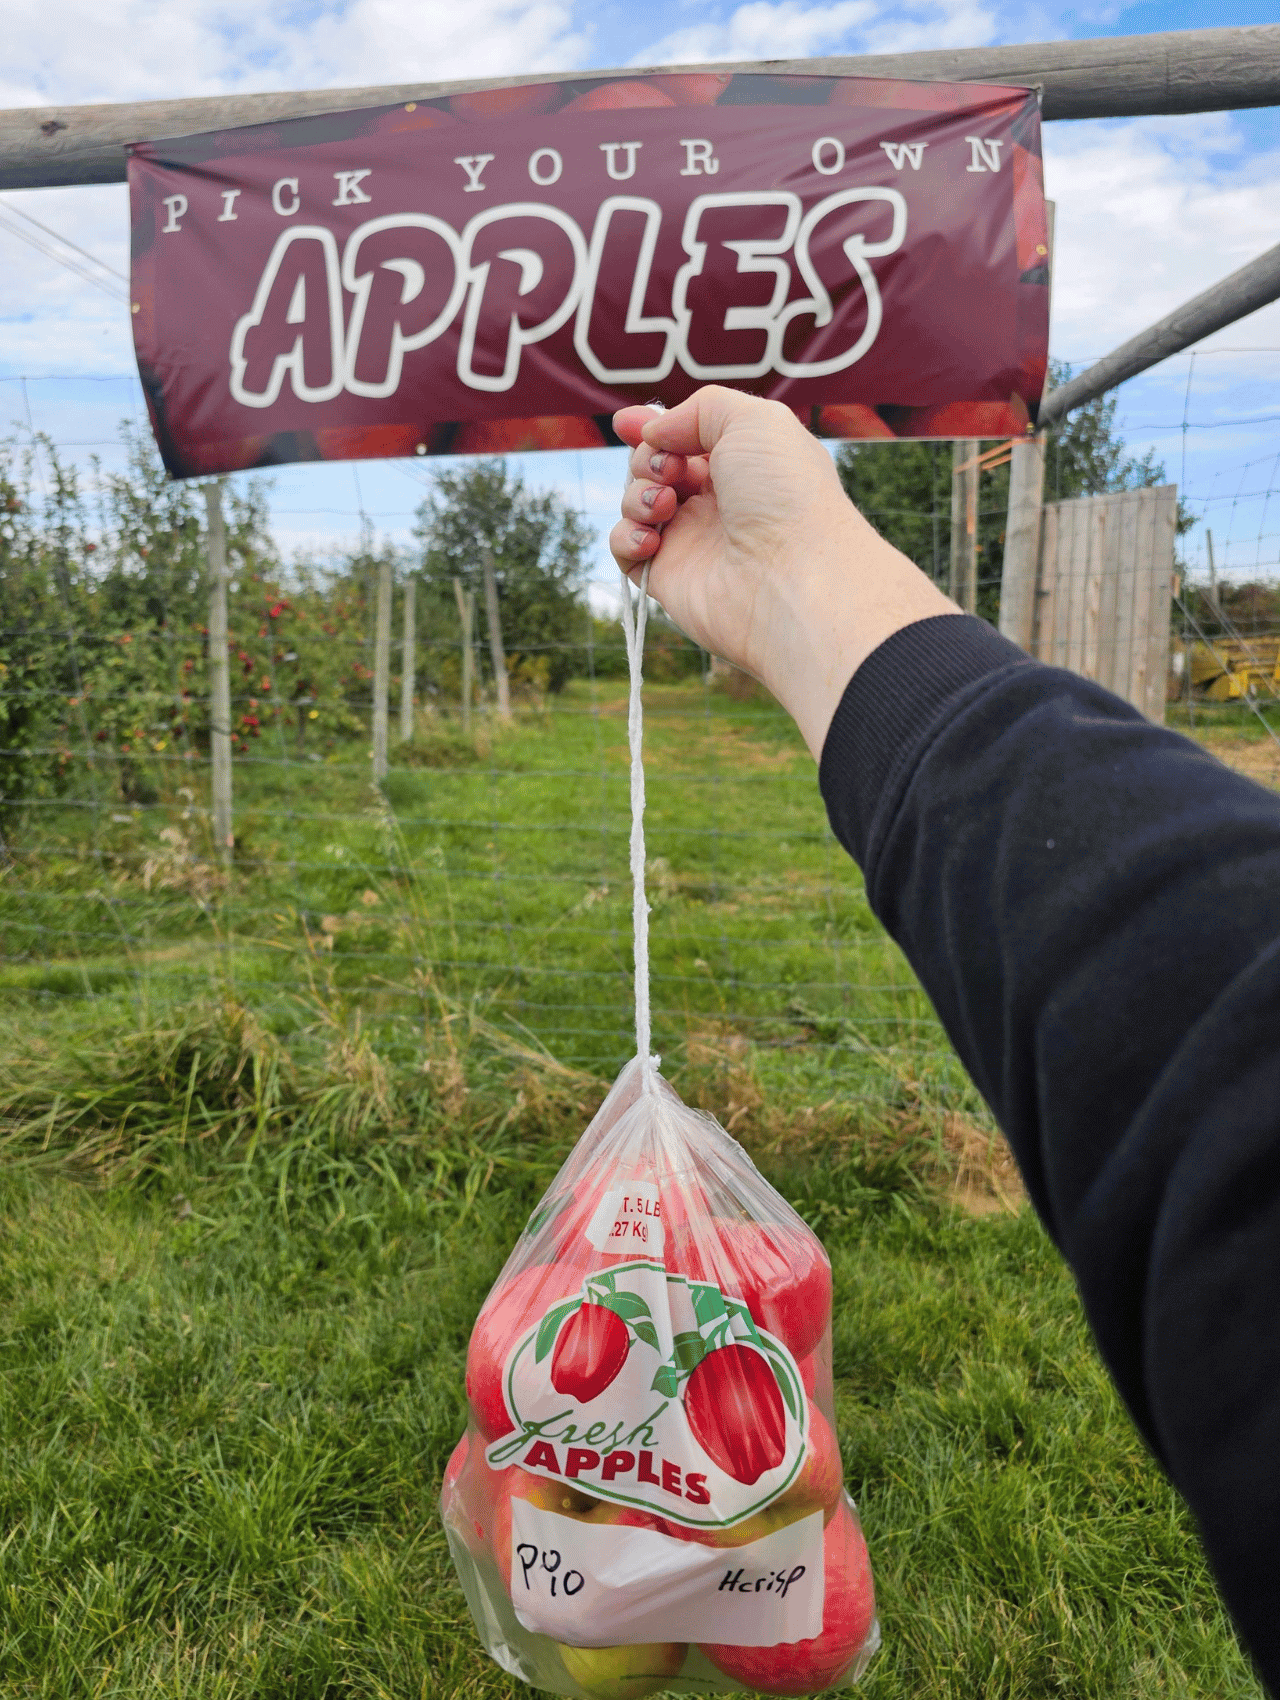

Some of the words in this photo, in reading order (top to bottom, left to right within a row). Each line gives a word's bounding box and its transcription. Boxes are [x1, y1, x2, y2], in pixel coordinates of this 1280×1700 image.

[162, 168, 373, 234] PICK
[454, 138, 720, 193] YOUR
[811, 136, 1005, 175] OWN
[228, 186, 908, 408] APPLES
[489, 1400, 670, 1463] fresh
[522, 1439, 711, 1505] APPLES
